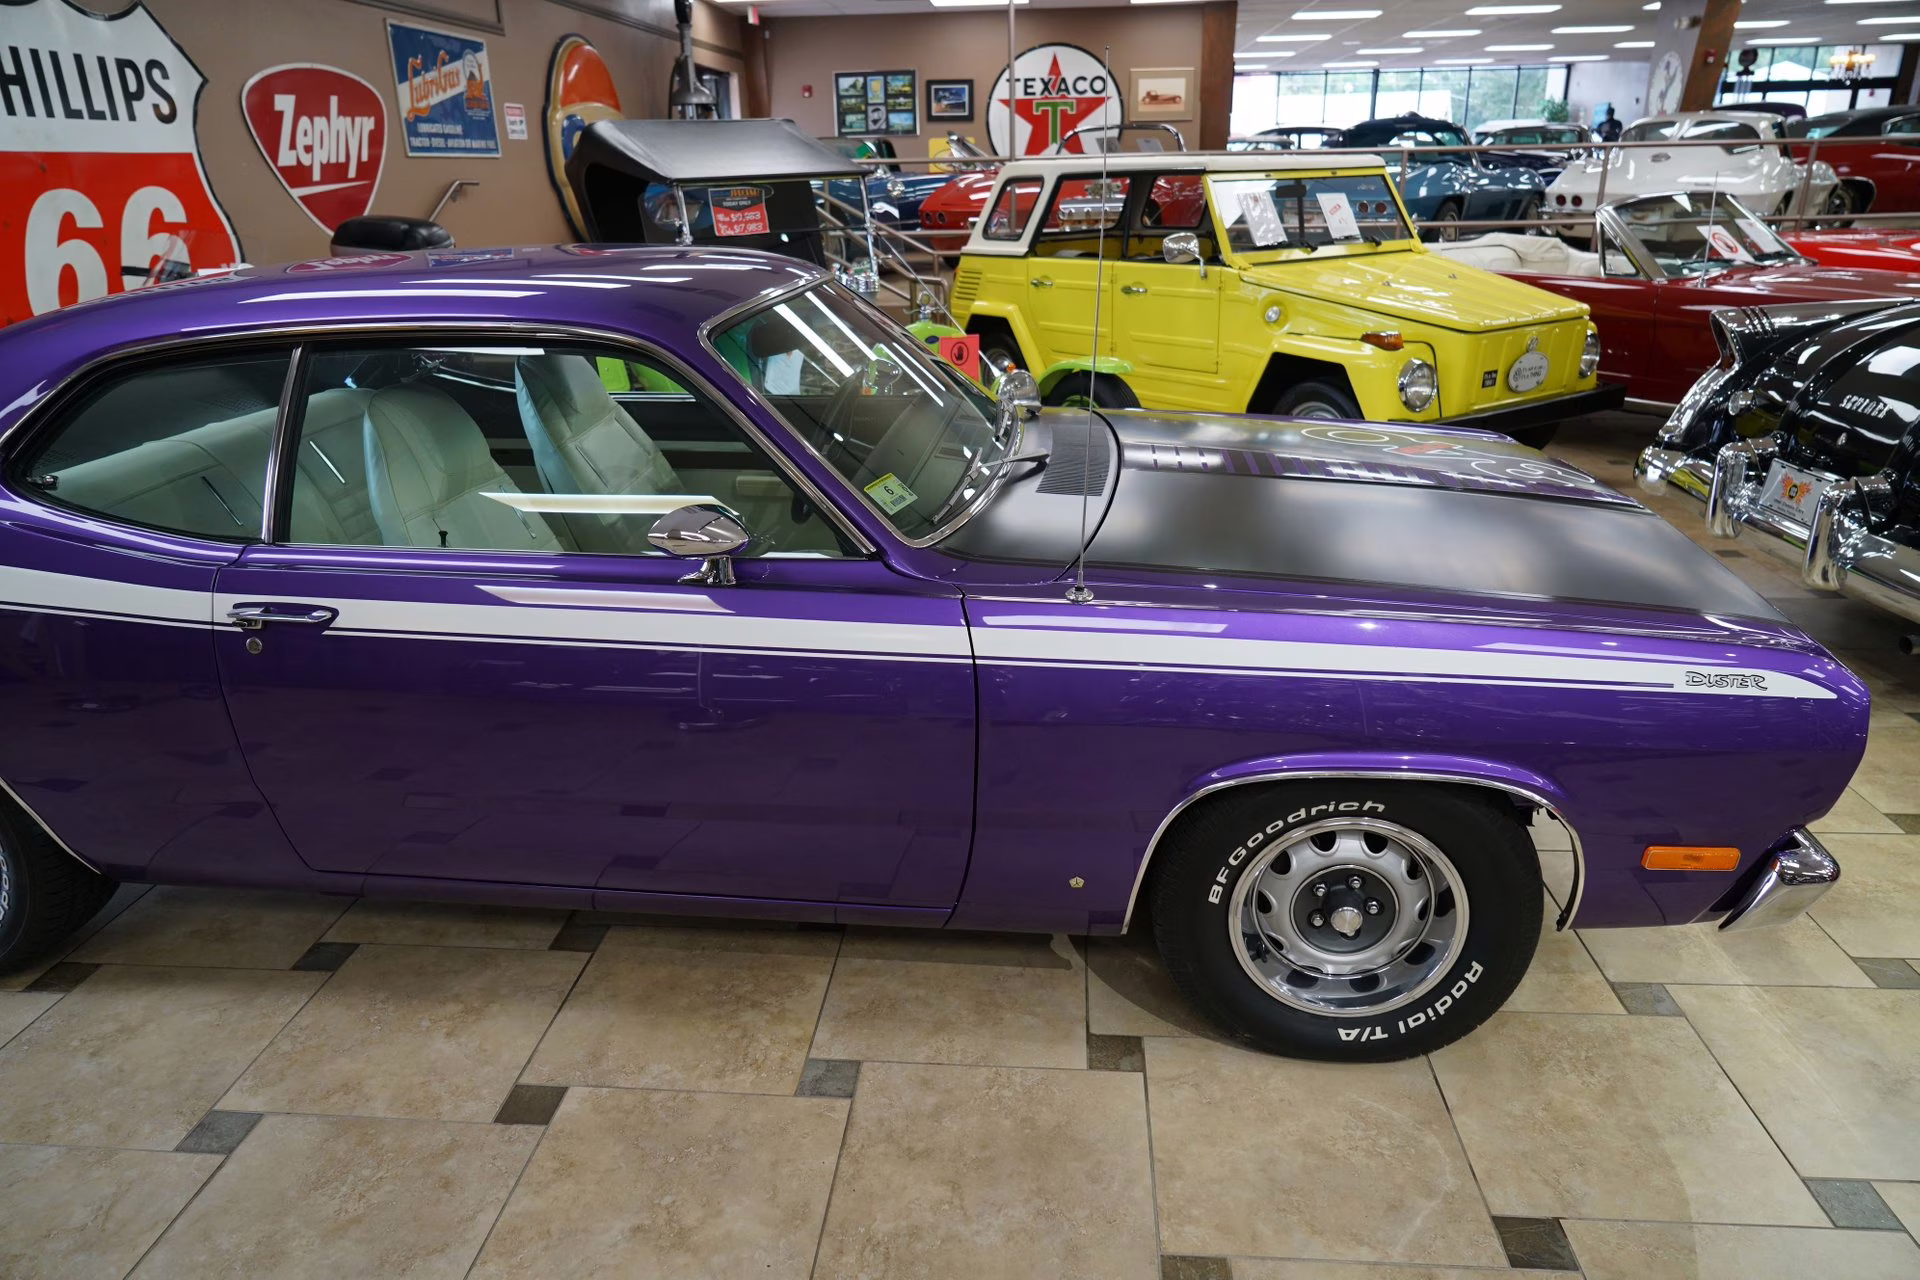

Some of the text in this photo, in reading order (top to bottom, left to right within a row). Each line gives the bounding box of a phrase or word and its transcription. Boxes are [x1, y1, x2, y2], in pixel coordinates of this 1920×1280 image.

[274, 93, 376, 182] Zephyr
[24, 185, 191, 317] 66
[1685, 670, 1769, 692] DUSTER
[1208, 800, 1386, 905] BFGoodrich
[1337, 960, 1484, 1042] Radial T/A
